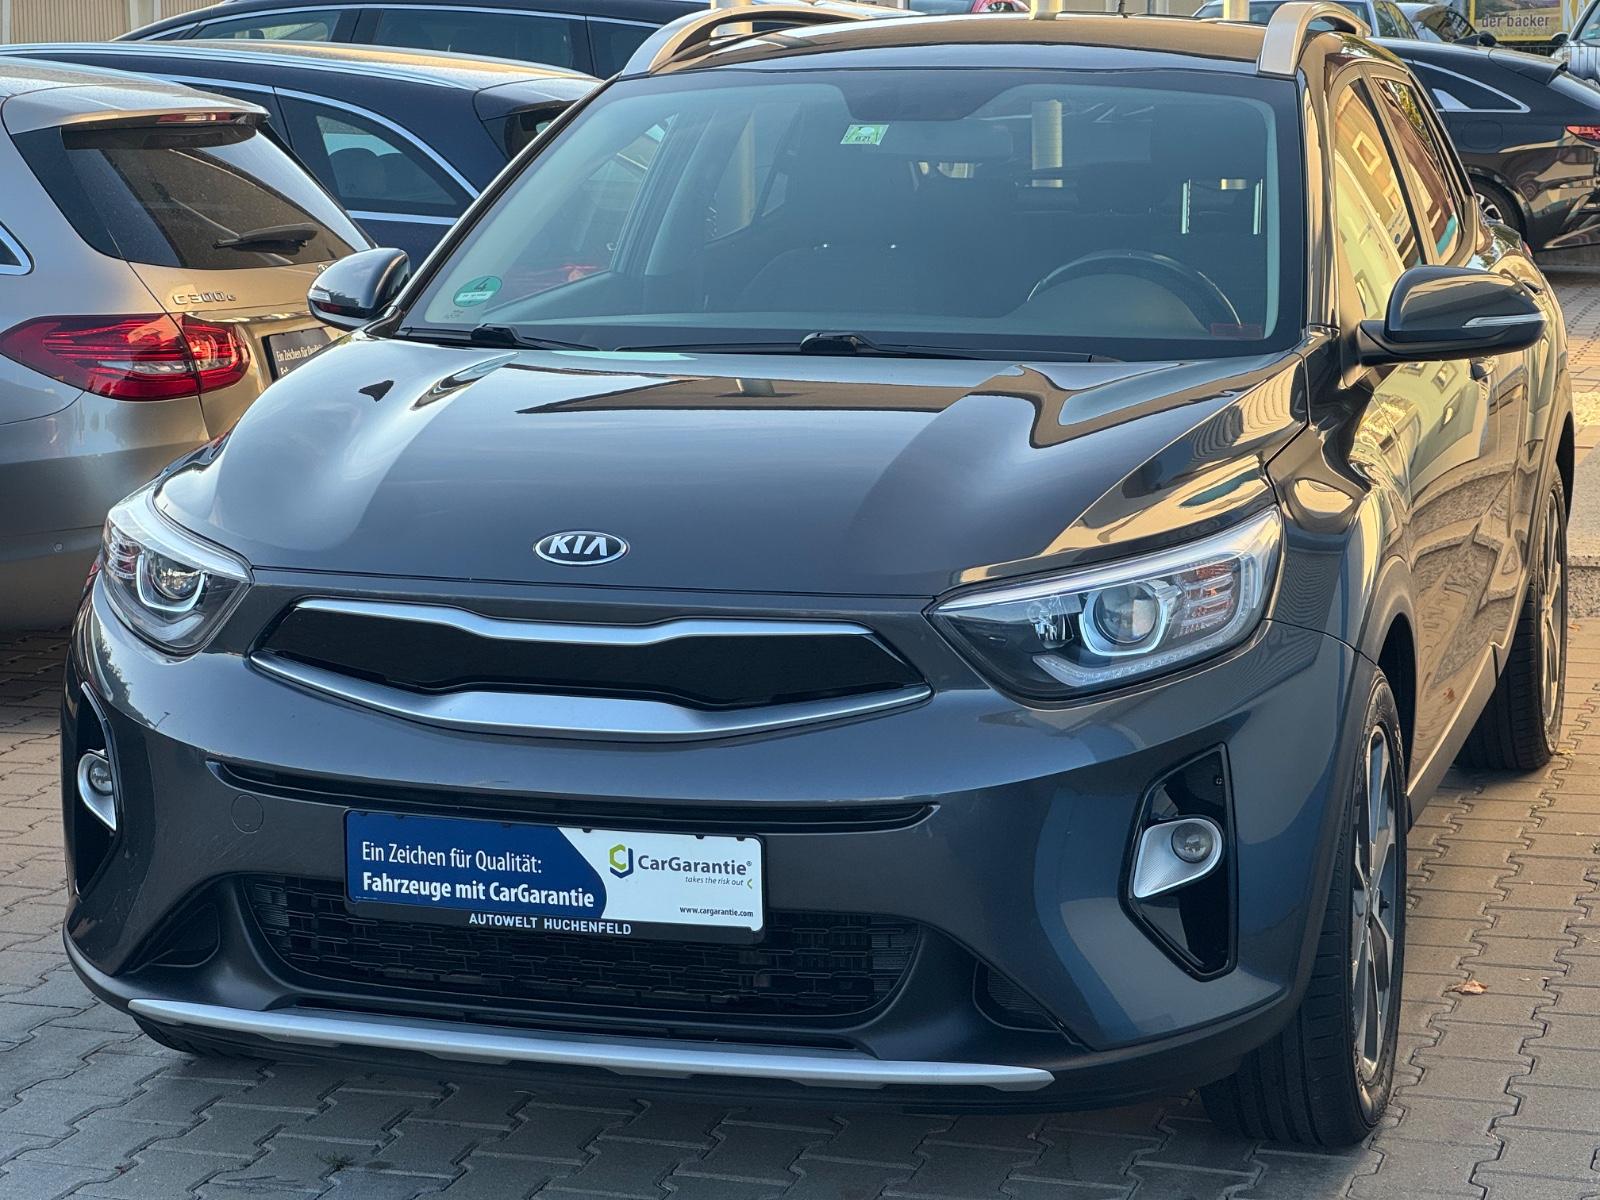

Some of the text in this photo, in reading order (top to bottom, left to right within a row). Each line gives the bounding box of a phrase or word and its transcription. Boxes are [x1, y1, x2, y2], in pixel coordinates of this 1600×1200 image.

[1481, 14, 1502, 28] der
[548, 535, 608, 557] KIA
[362, 841, 542, 874] Ein Zeichen für Qualität:
[362, 871, 595, 908] Fahrzeuge mit CarGarantie
[685, 875, 744, 887] takes the risk out
[679, 905, 754, 918] www.cargarantie.com
[468, 912, 632, 936] AUTOWELT HUCHENFELD
